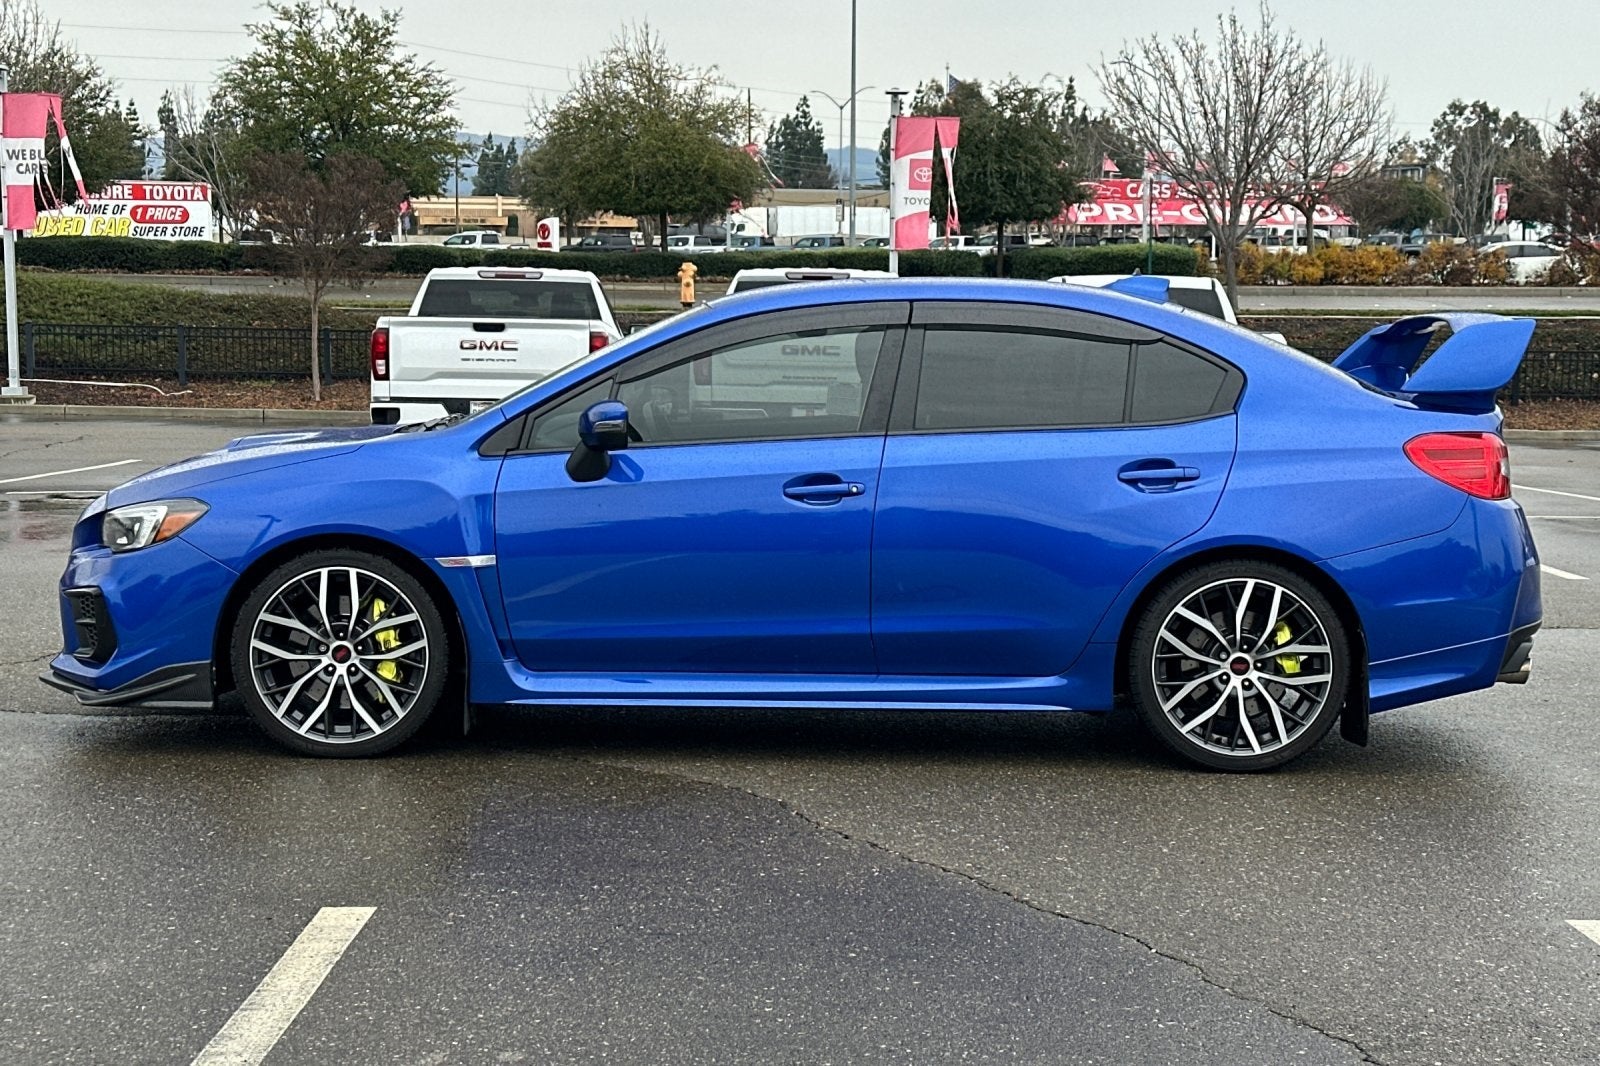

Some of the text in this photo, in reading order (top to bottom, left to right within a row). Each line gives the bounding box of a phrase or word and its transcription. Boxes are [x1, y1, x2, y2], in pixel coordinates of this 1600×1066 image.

[6, 148, 27, 160] WE
[142, 185, 205, 201] TOYOTA
[75, 203, 127, 216] HOME OF
[135, 206, 184, 221] 1 PRICE
[1077, 203, 1339, 223] PRE-OD
[33, 216, 131, 237] USED CAR
[132, 226, 206, 238] SUPER STORE
[459, 339, 519, 352] GMC
[781, 344, 841, 357] GMC
